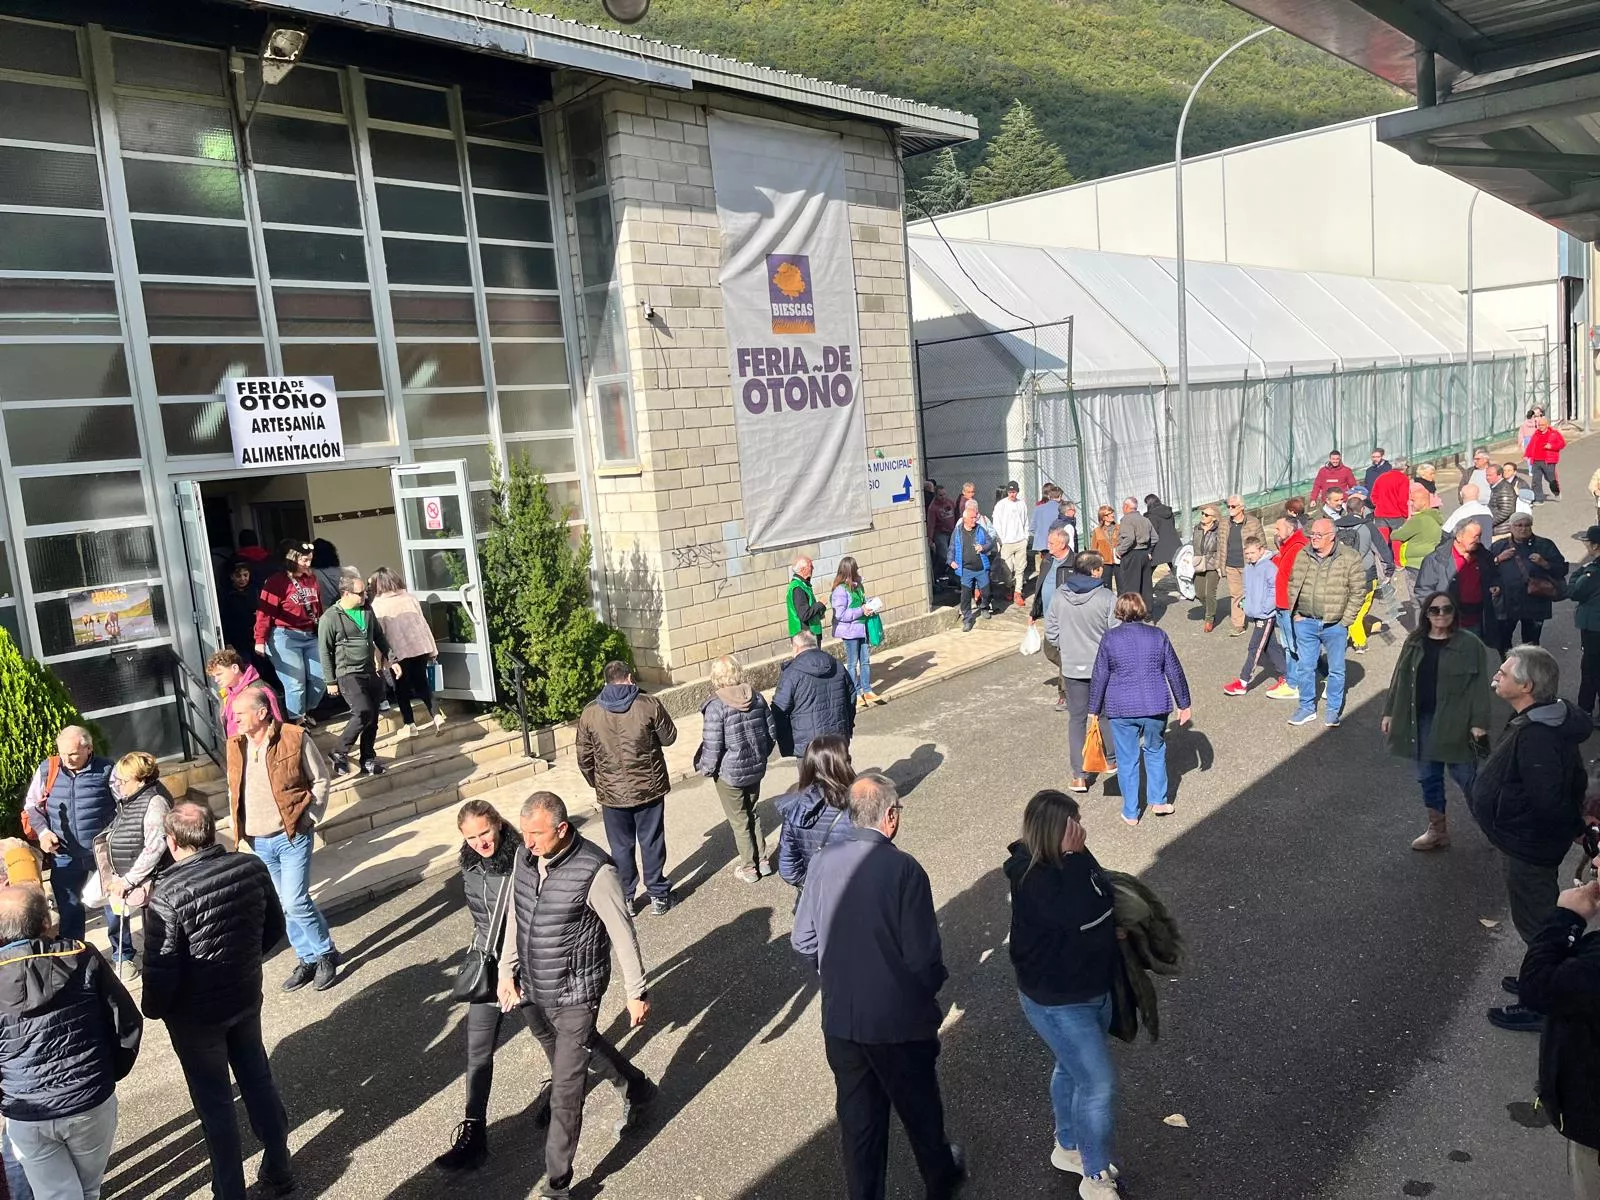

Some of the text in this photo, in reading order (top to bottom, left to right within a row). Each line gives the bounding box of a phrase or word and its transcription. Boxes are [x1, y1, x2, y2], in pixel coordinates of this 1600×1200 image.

[771, 303, 814, 317] BIESCAS
[736, 345, 853, 378] FERIA DE
[237, 380, 304, 395] FERIA DE
[742, 365, 853, 414] OTOÑO
[240, 389, 326, 411] OTOÑO
[252, 412, 325, 433] ARTESANÍA
[287, 434, 294, 442] Y
[242, 439, 340, 464] ALIMENTACIÓN
[873, 459, 912, 473] MUNICIPAL
